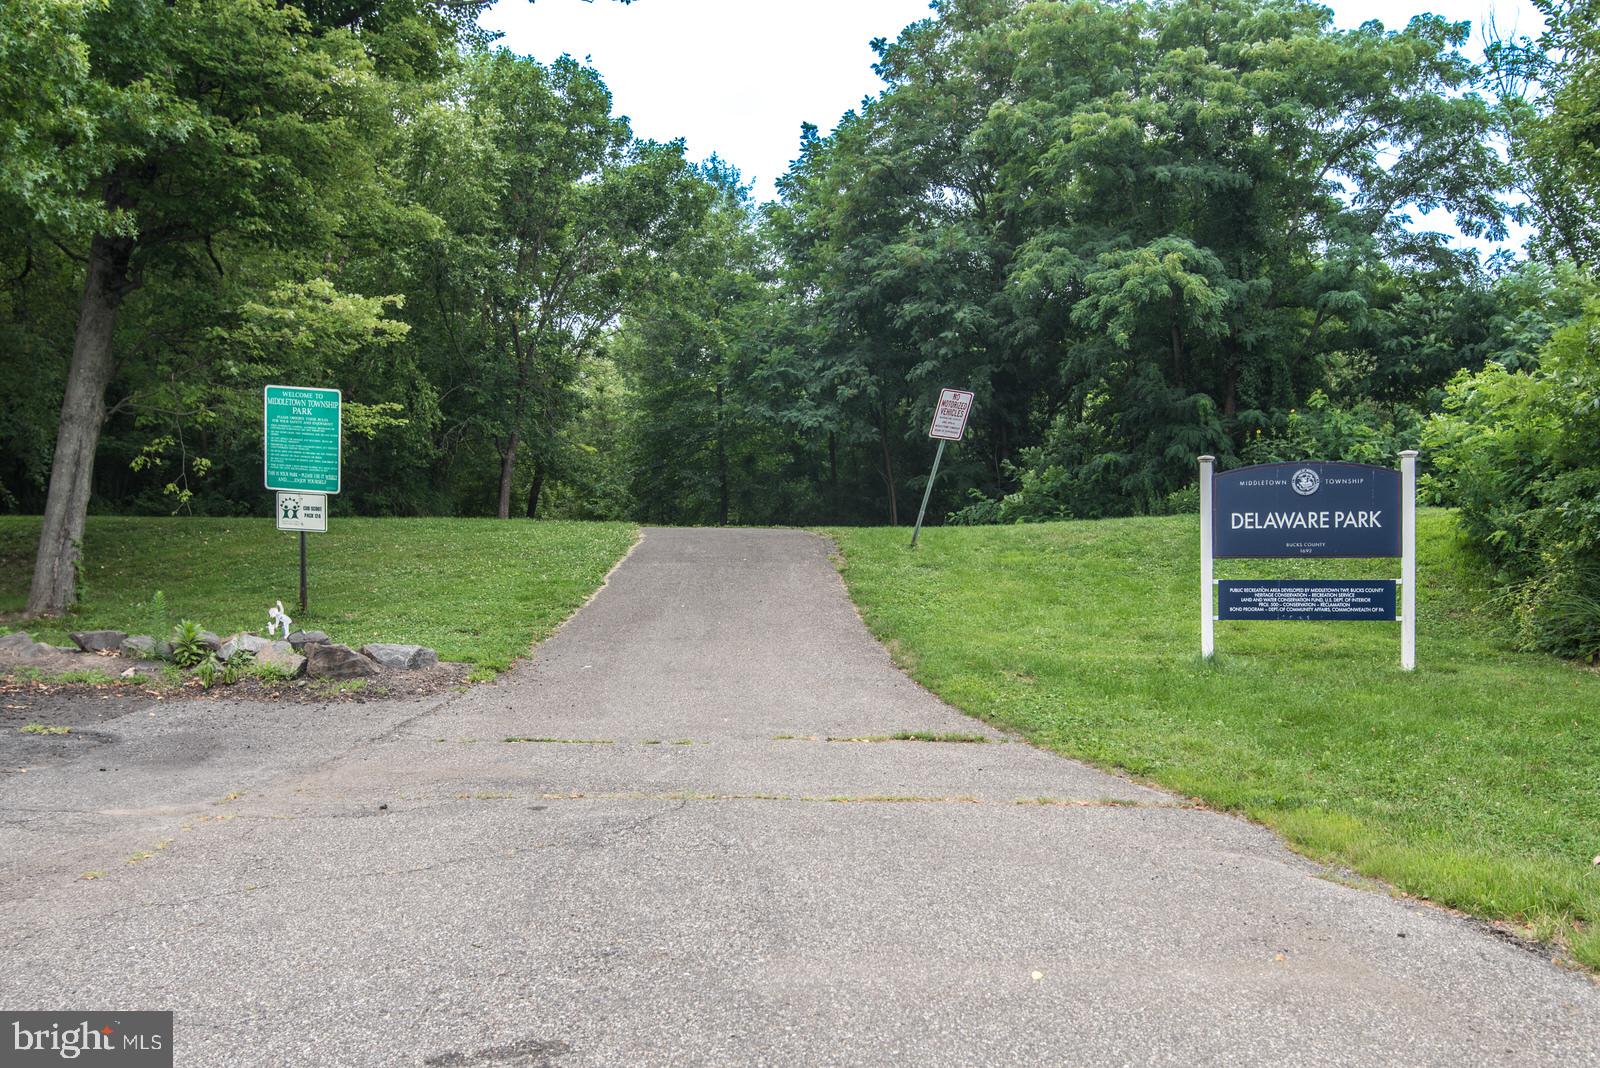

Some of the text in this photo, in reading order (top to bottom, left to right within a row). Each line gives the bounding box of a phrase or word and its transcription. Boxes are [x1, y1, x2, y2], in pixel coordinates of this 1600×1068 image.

[268, 397, 338, 408] MIDDLETOWN TOWNSHIP
[942, 400, 967, 410] MOTORIZED
[292, 407, 312, 415] PARK
[941, 408, 964, 417] VEHICLES
[1231, 510, 1382, 530] DELAWARE PARK
